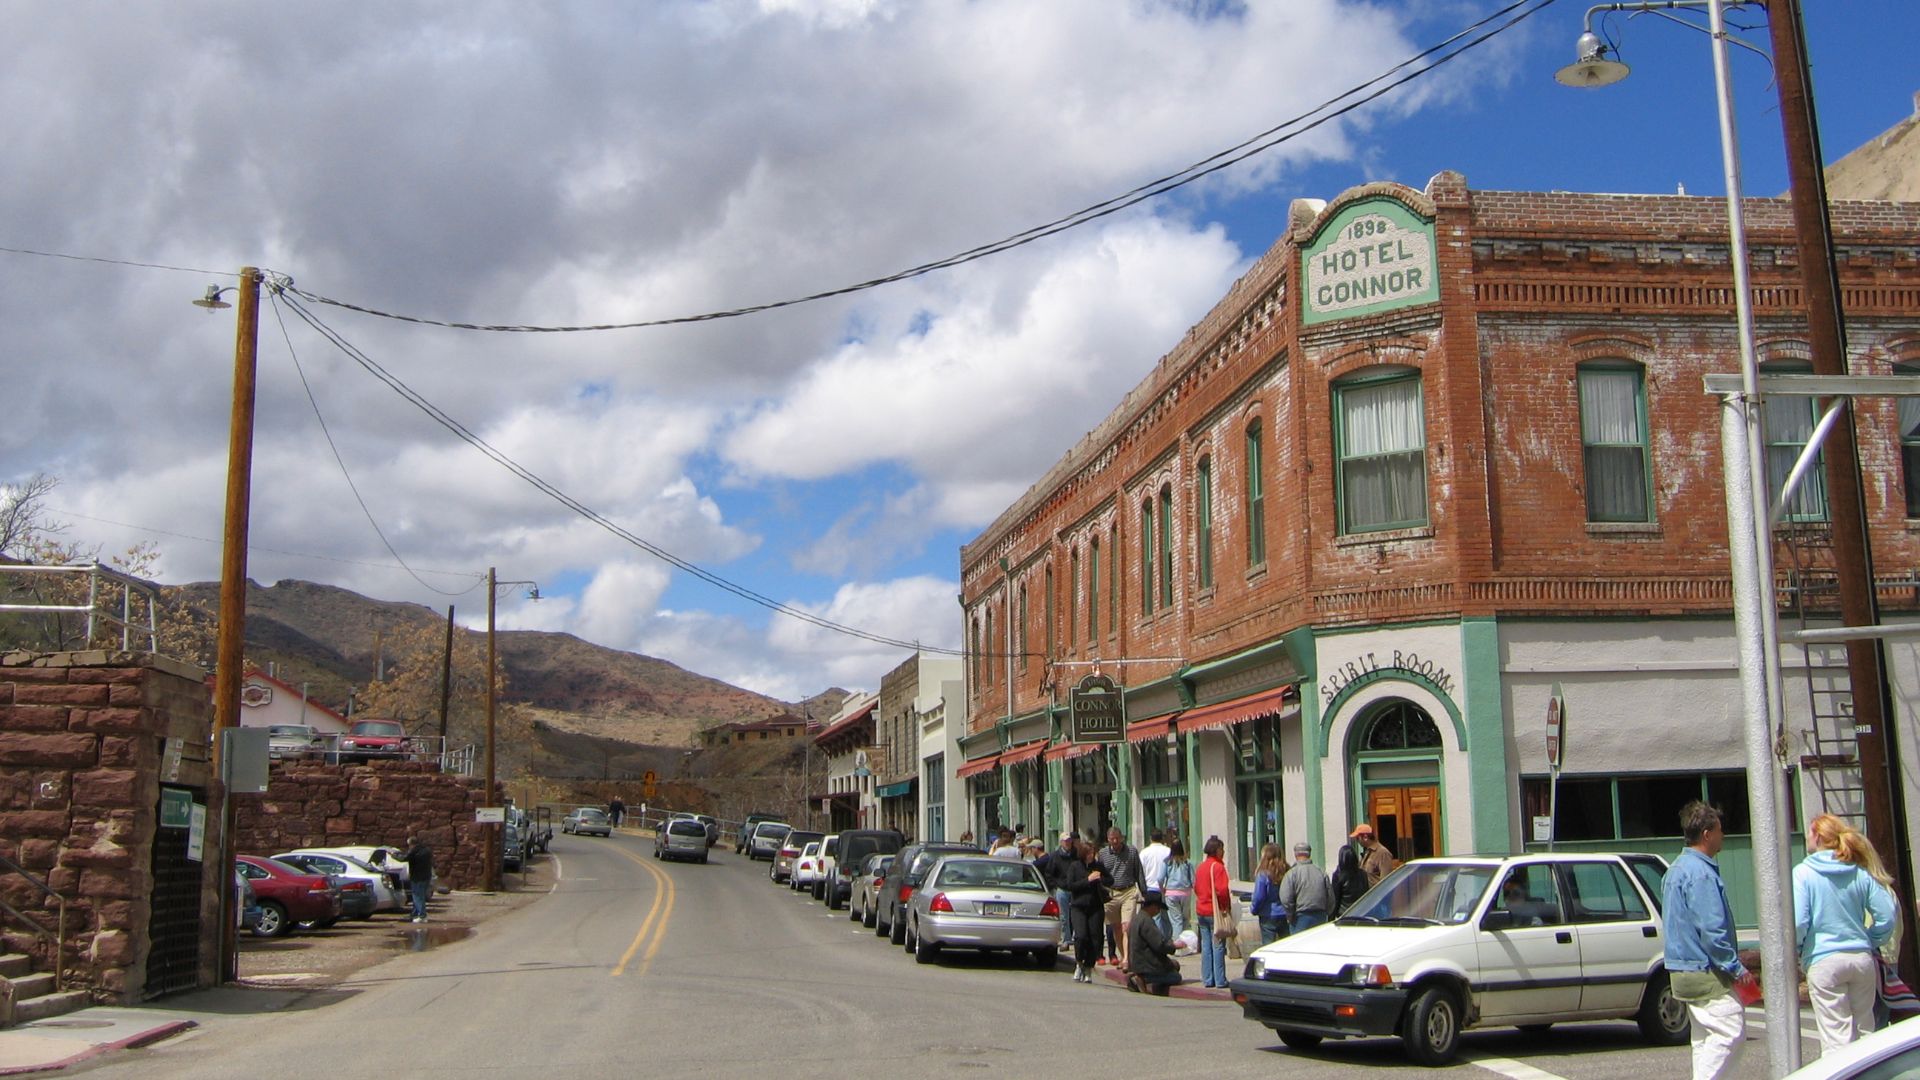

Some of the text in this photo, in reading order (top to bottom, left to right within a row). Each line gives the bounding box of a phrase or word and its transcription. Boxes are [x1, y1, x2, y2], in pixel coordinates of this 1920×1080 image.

[1348, 219, 1387, 240] 1898
[1322, 239, 1414, 276] HOTEL
[1317, 267, 1422, 306] CONNOR
[1320, 649, 1452, 701] SPIRIT ROOM
[1080, 716, 1119, 729] HOTEL
